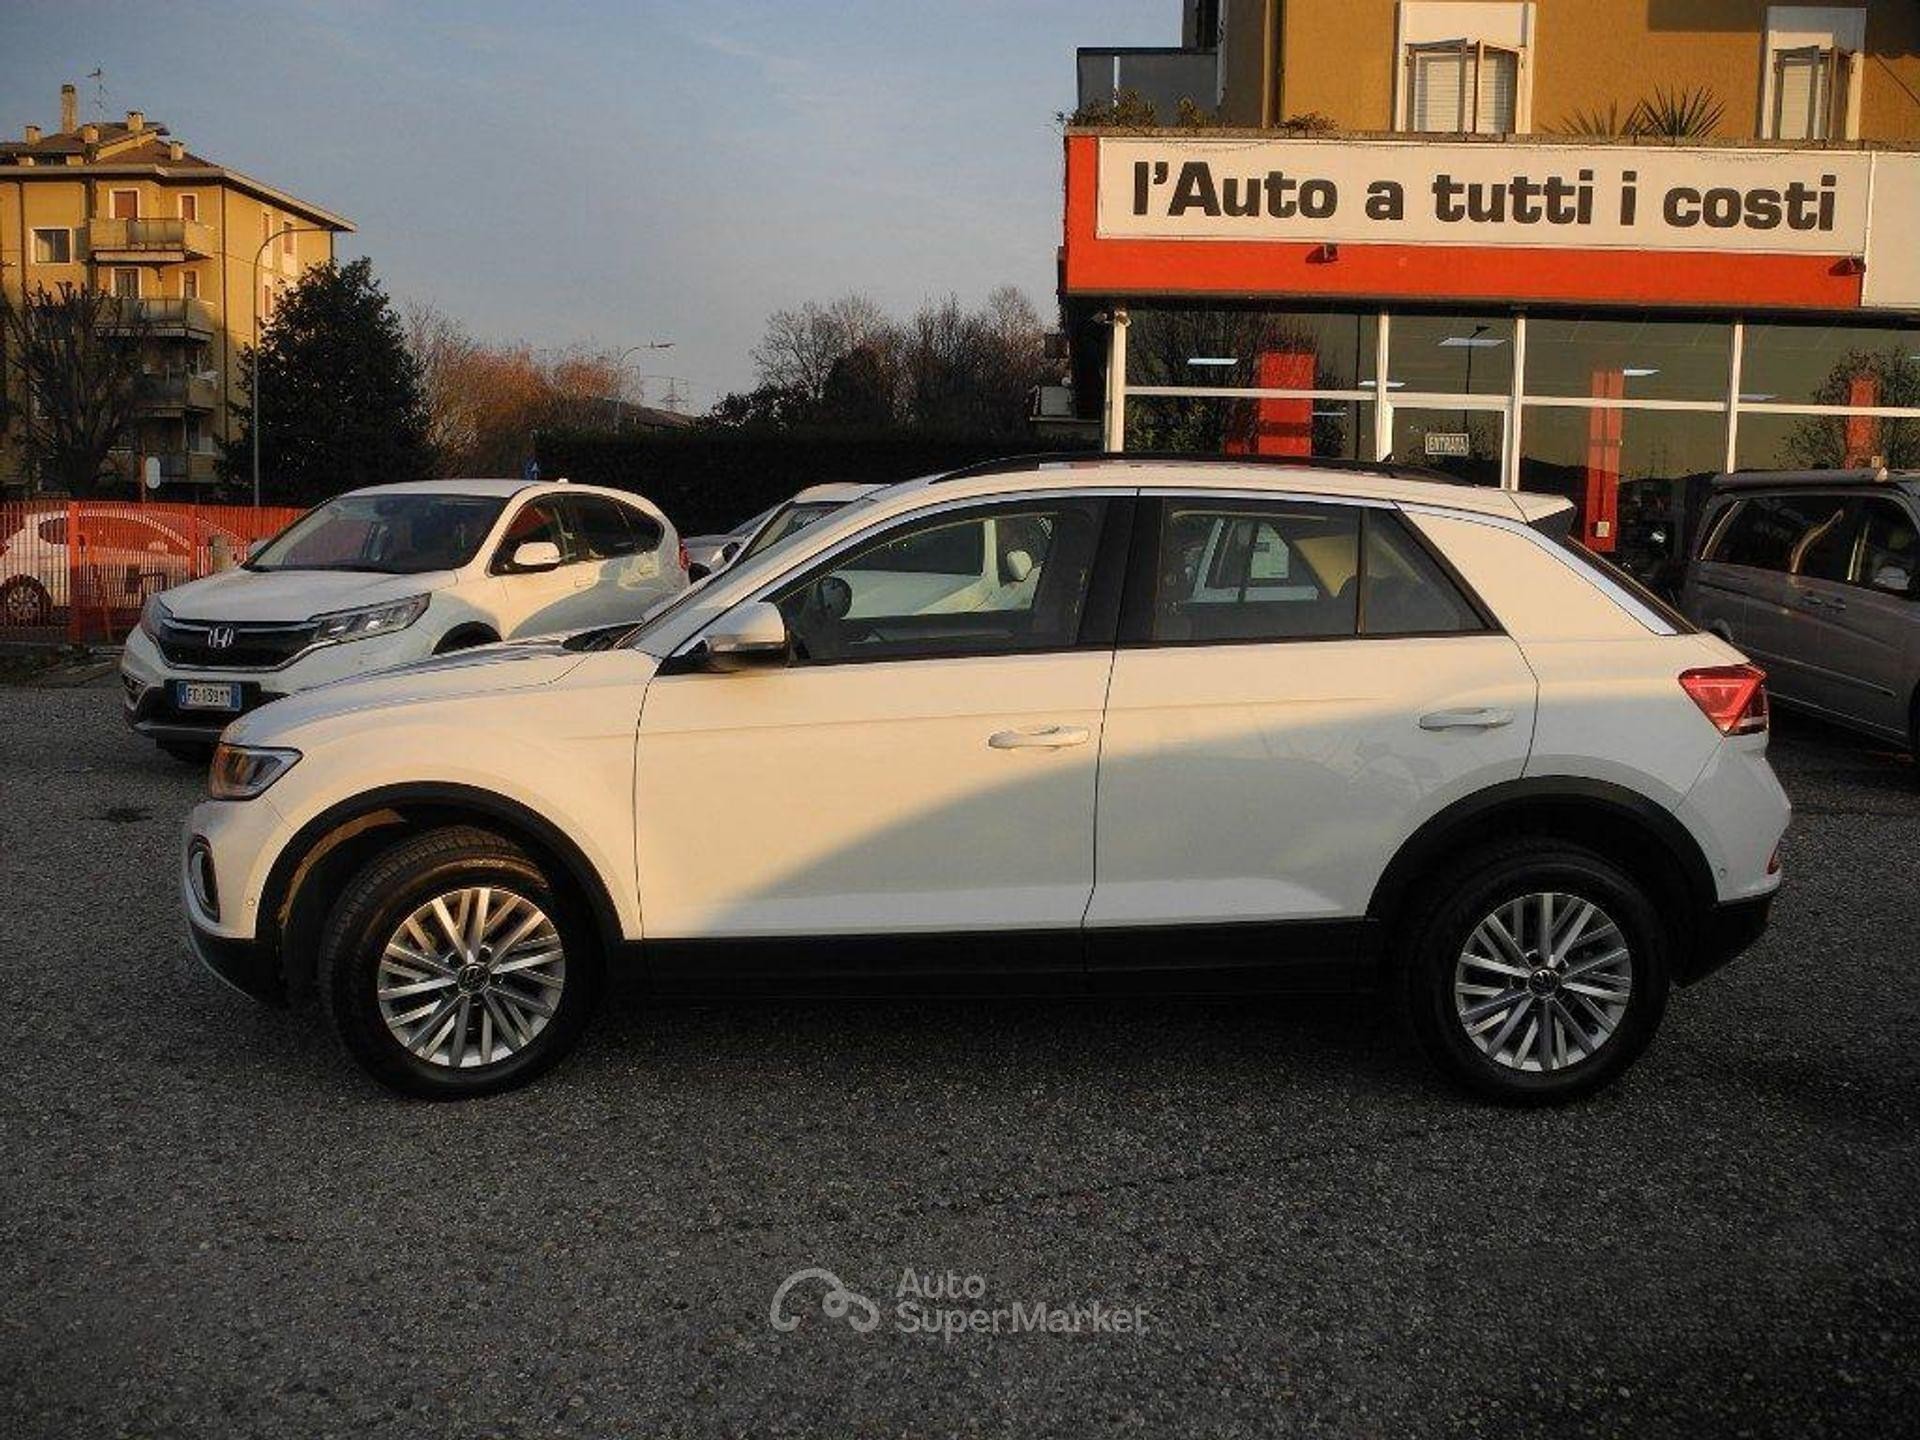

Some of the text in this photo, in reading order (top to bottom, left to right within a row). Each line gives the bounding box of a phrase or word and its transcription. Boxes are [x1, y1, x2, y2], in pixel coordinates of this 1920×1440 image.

[1365, 180, 1404, 221] a
[1432, 169, 1594, 225] tutti
[1620, 171, 1637, 226] i
[1663, 174, 1837, 232] costi
